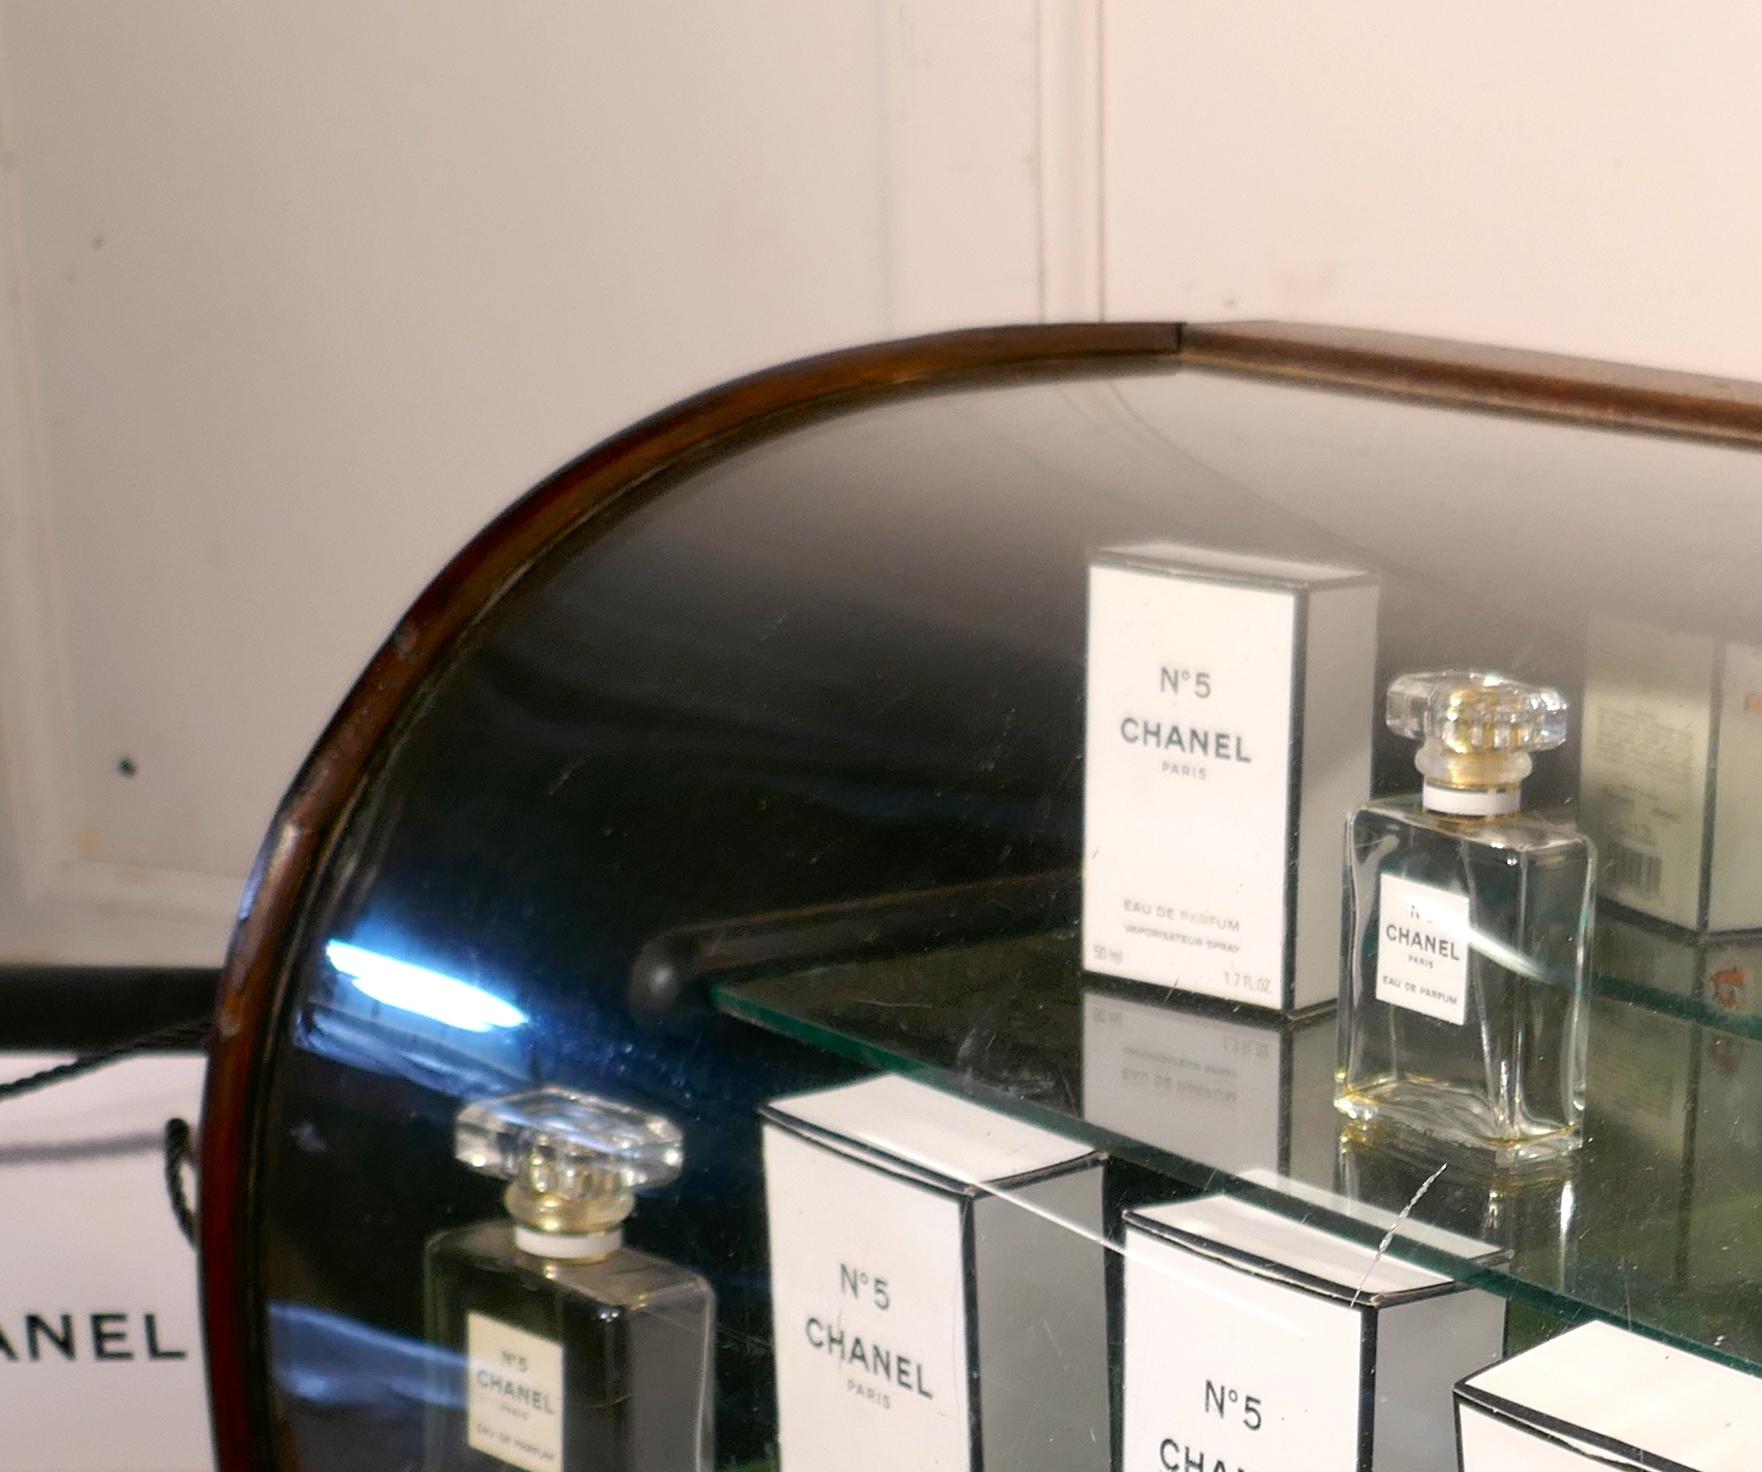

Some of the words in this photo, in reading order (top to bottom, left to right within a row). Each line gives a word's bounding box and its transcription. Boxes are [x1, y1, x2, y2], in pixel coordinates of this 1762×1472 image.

[1120, 716, 1252, 763] CHANEL
[1162, 761, 1207, 780] PARIS
[1124, 899, 1151, 915] EAU
[1157, 907, 1175, 920] DE
[1180, 911, 1240, 933] PARFUM
[1385, 924, 1460, 961] CHANEL
[1408, 954, 1434, 970] PARIS
[1382, 975, 1400, 989] EAU
[1405, 982, 1416, 993] DE
[1420, 987, 1458, 1006] PARFUM
[806, 1317, 934, 1400] CHANEL
[477, 1369, 554, 1415] CHANEL
[847, 1379, 891, 1410] PARIS
